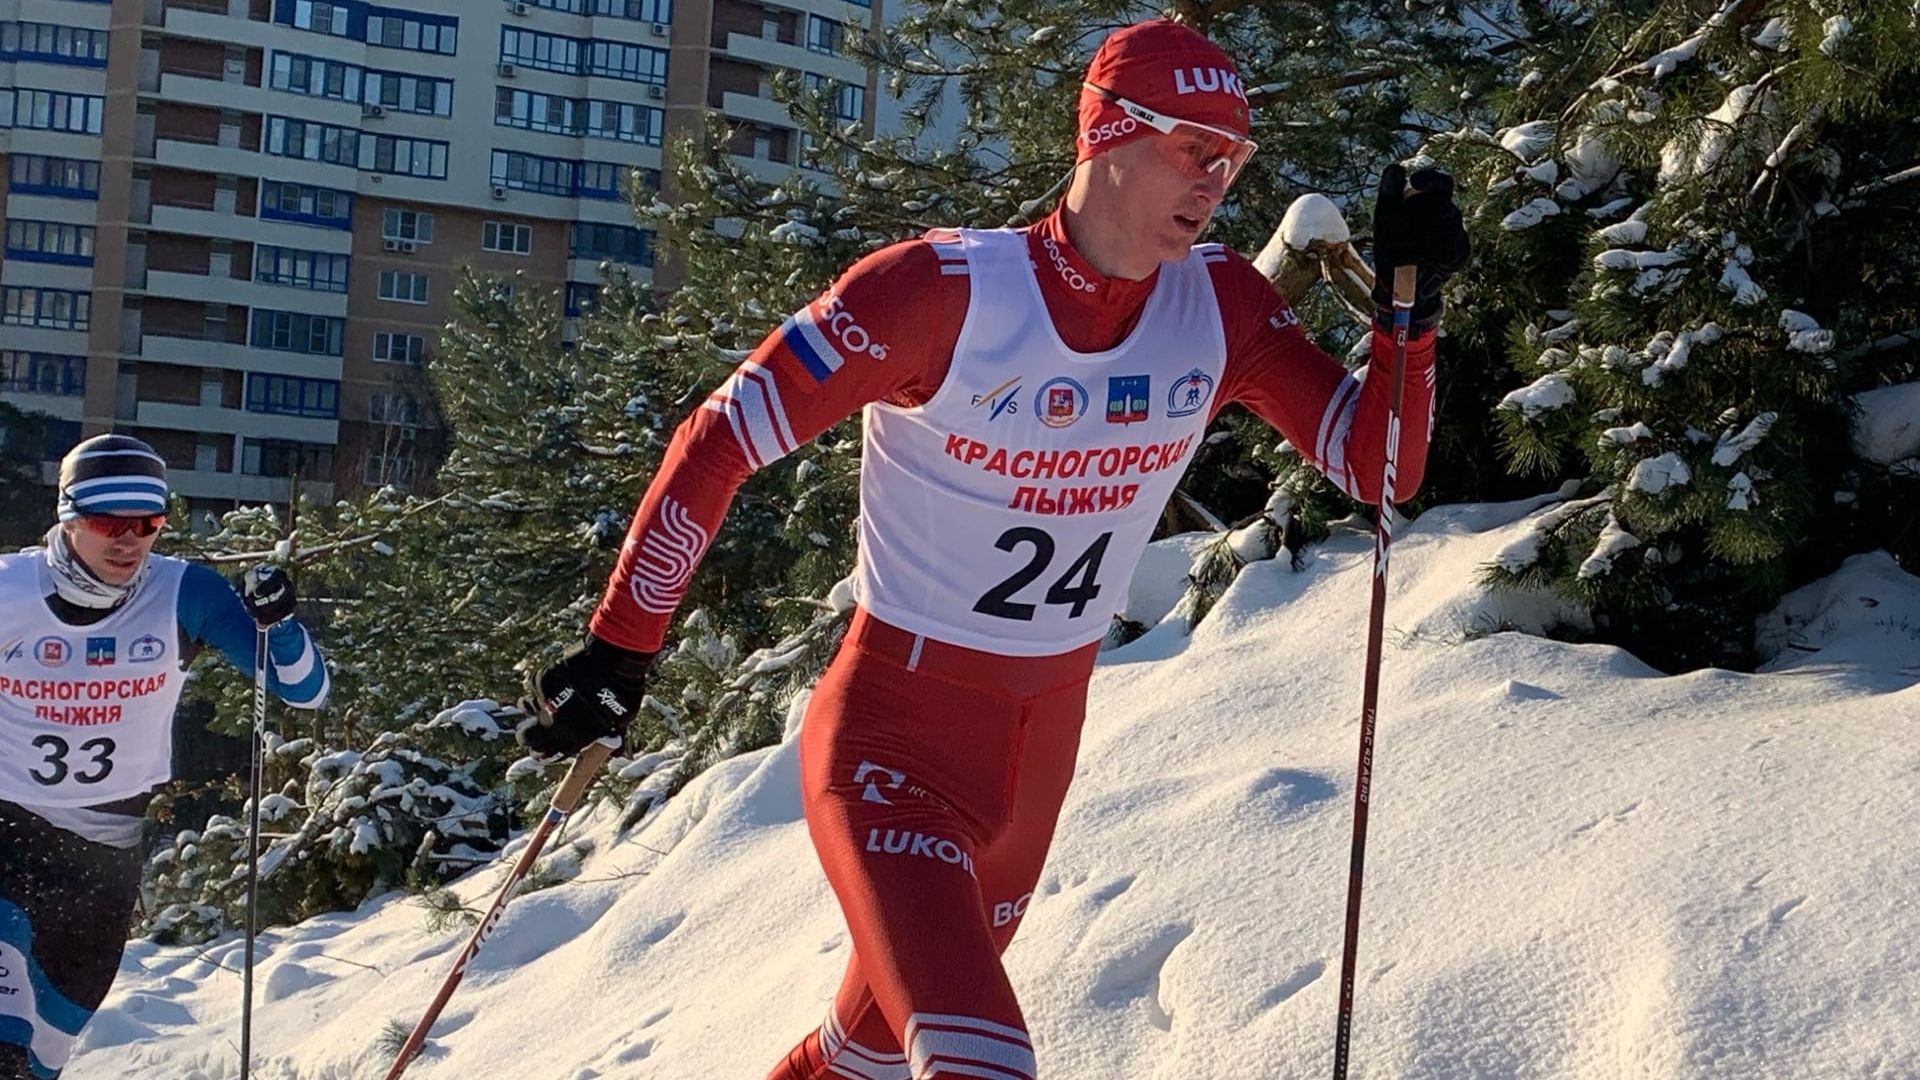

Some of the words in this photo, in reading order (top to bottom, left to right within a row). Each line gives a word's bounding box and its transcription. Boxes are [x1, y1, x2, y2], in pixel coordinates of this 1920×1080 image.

[1087, 117, 1137, 145] OSCO
[1008, 484, 1140, 516] ЛЫЖНЯ
[972, 526, 1114, 622] 24
[0, 672, 167, 700] РАСНОГОРСКАЯ
[35, 704, 122, 726] ЛЫЖНЯ
[28, 734, 117, 786] 33
